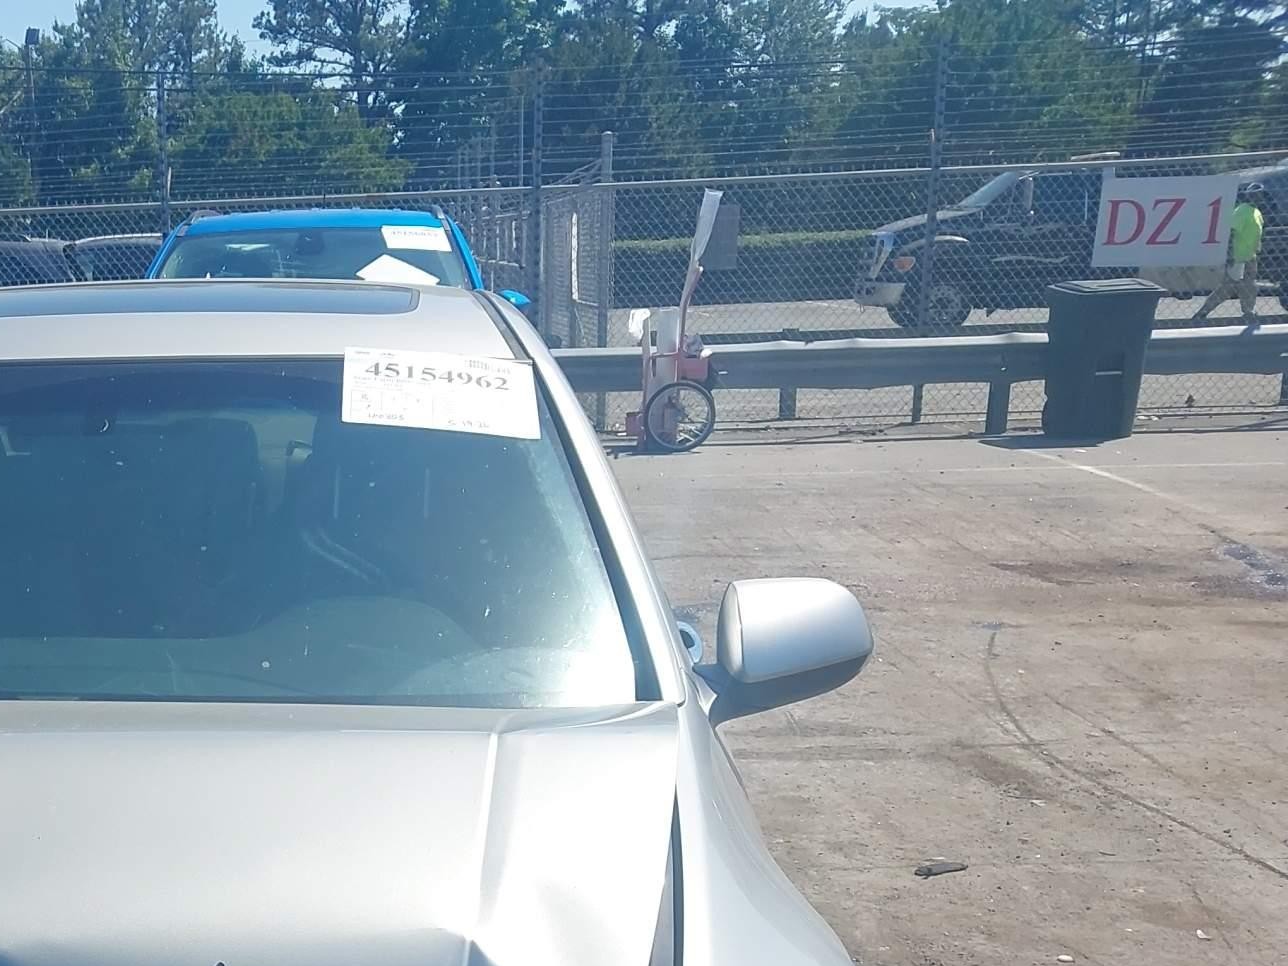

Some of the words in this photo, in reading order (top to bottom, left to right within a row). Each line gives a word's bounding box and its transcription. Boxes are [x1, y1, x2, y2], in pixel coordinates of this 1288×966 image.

[1101, 197, 1187, 246] DZ
[1200, 196, 1223, 244] 1
[364, 361, 511, 391] 45154962
